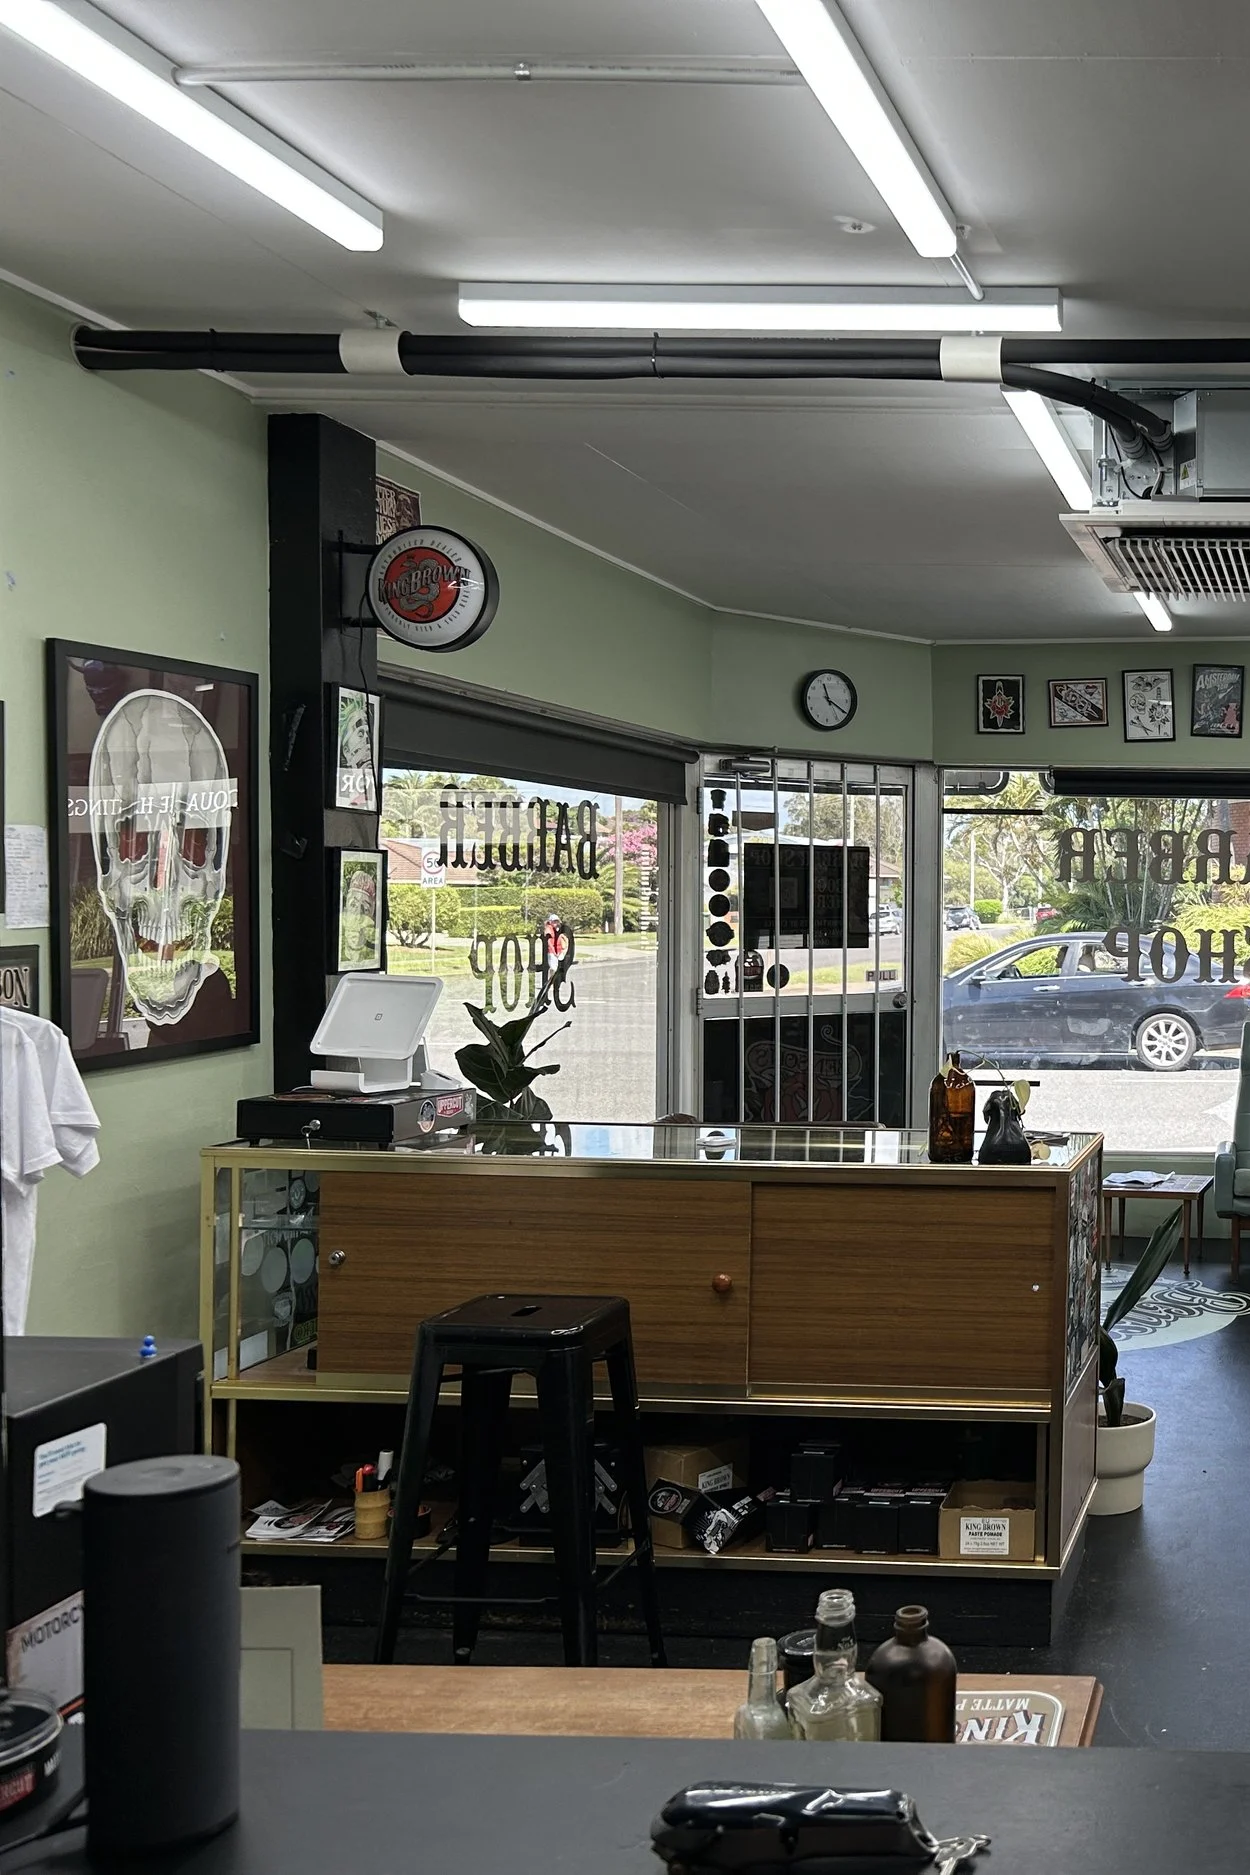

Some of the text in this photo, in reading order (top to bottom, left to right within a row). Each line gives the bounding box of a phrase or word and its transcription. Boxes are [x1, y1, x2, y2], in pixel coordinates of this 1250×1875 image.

[378, 566, 472, 605] KING BROWN
[965, 1522, 1006, 1531] KING BROWN
[20, 1604, 84, 1652] MOTORC
[970, 1697, 1030, 1711] MATTE
[955, 1709, 1046, 1745] KIN
